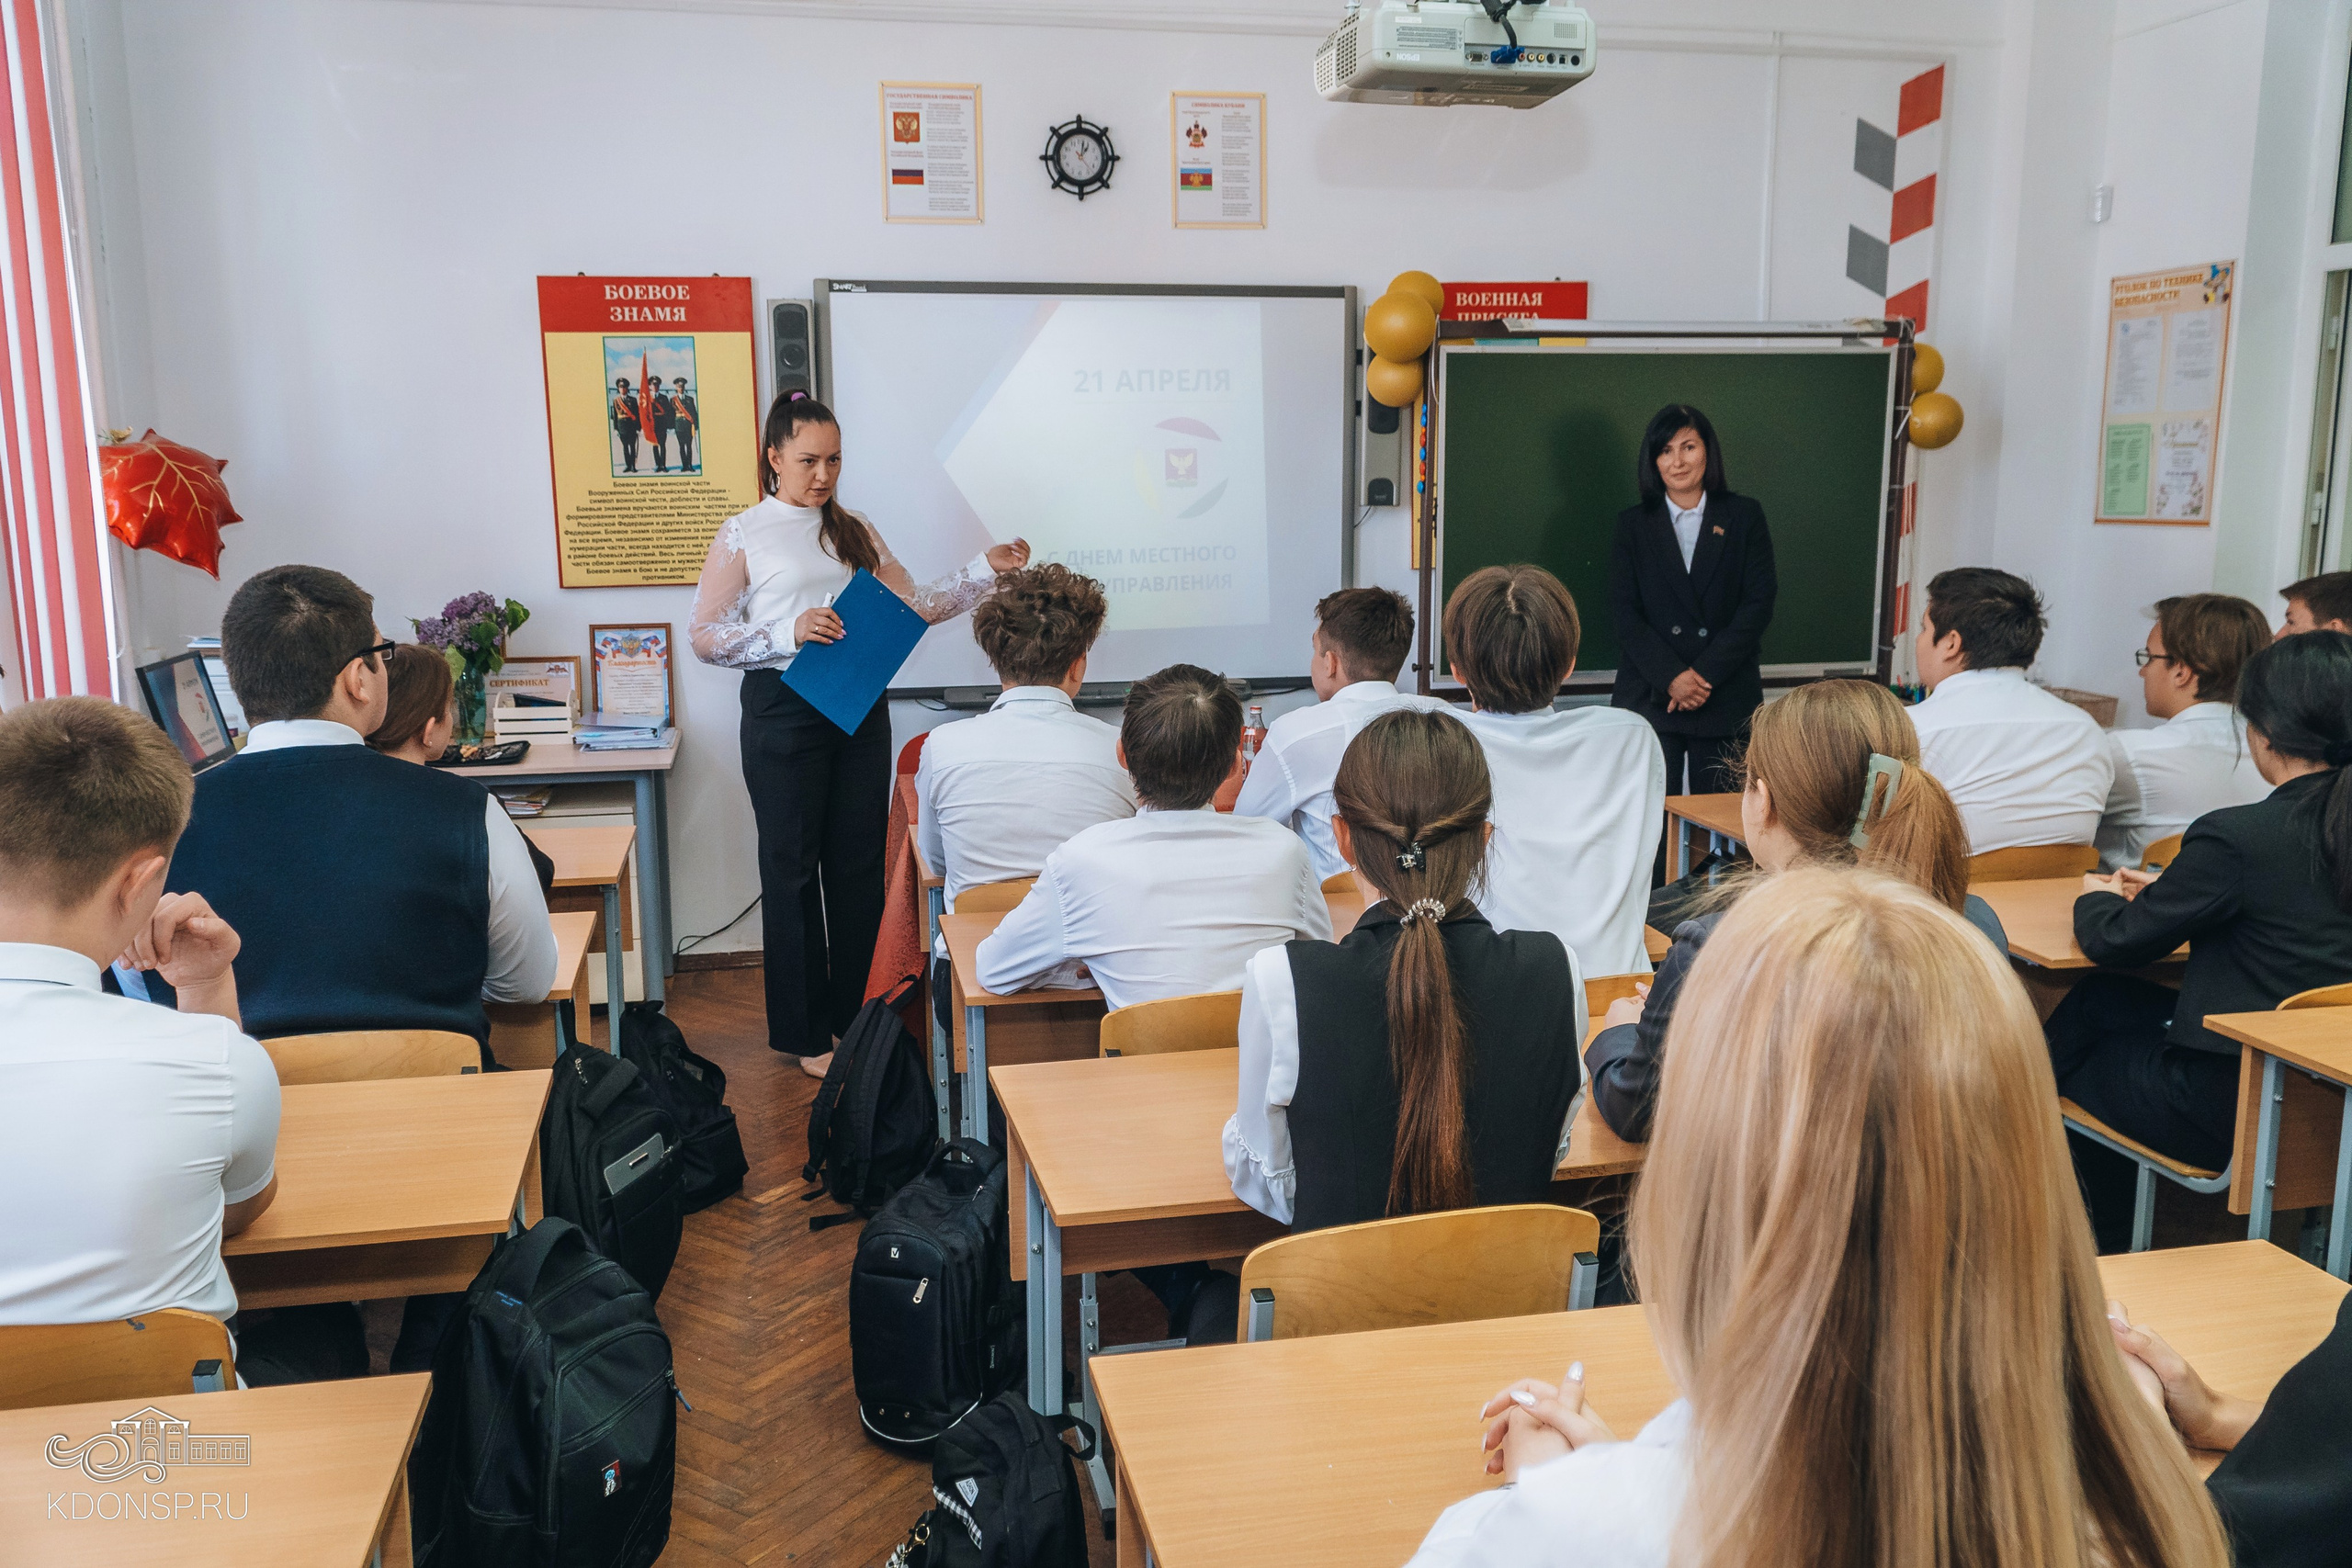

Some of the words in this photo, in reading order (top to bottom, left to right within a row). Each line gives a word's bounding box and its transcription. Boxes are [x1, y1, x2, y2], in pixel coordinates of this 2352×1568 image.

[1396, 52, 1419, 62] EPSON
[604, 284, 690, 300] БОЕВОЕ
[1456, 292, 1543, 307] ВОЕННАЯ
[610, 306, 686, 322] ЗНАМЯ
[1074, 369, 1102, 392] 21
[1115, 368, 1230, 392] АПРЕЛЯ
[1046, 551, 1058, 562] С
[1066, 548, 1124, 568] ДНЕМ
[1130, 545, 1237, 563] МЕСТНОГО
[1102, 573, 1233, 593] УПРАВЛЕНИЯ
[489, 679, 550, 687] СЕРТИФИКАТ
